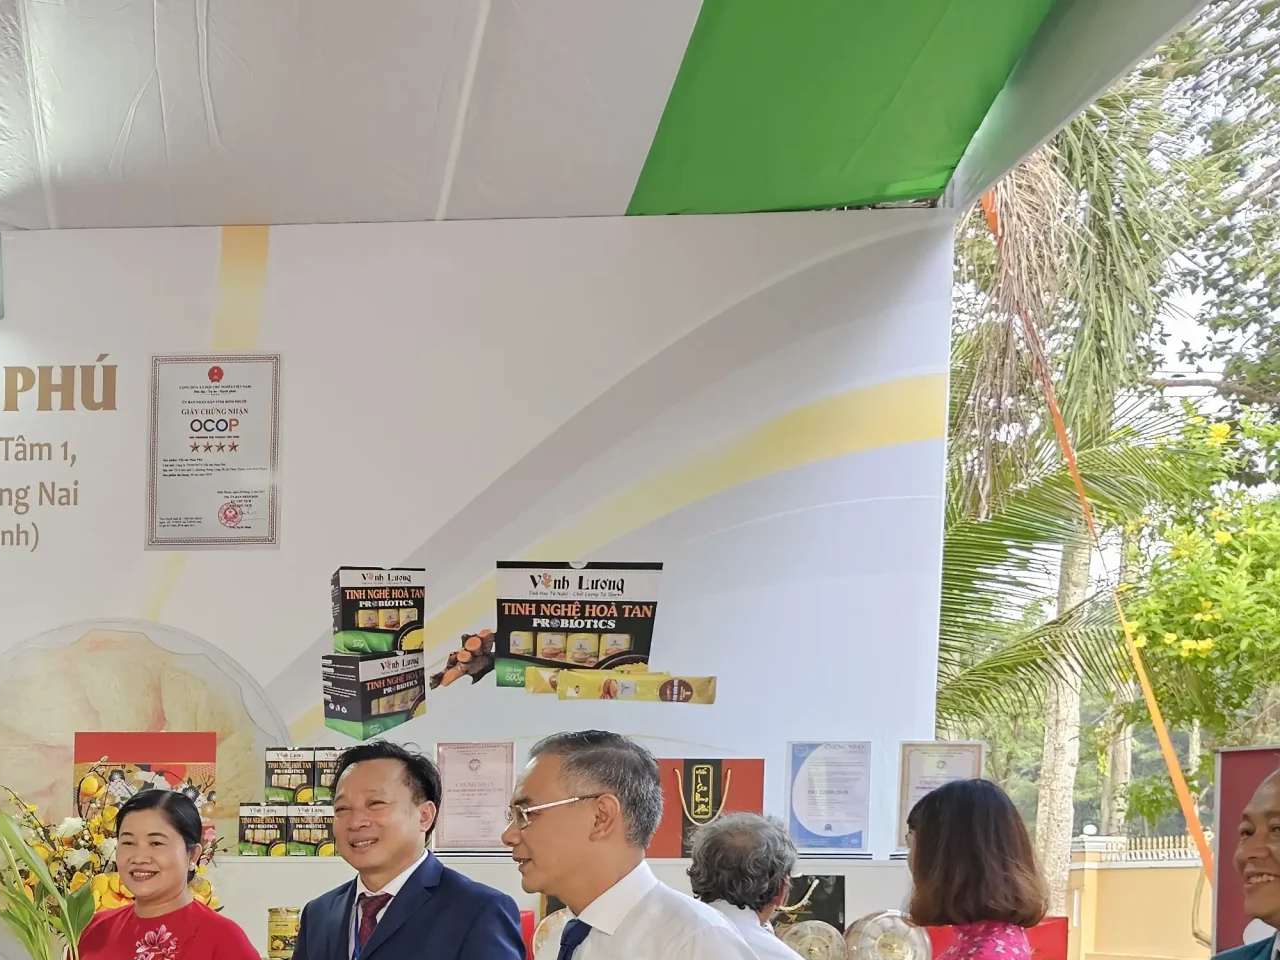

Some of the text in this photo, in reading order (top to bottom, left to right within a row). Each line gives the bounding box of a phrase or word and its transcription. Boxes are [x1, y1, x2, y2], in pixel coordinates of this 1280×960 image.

[3, 354, 118, 411] PHÚ
[190, 419, 239, 432] OCOP
[0, 435, 52, 461] Tâm
[61, 441, 76, 467] 1,
[39, 479, 79, 506] Nai
[345, 590, 365, 599] TINH
[368, 587, 390, 599] NGHỆ
[410, 589, 425, 598] TAN
[578, 576, 624, 596] Lương
[359, 600, 413, 608] PROBIOTICS
[502, 603, 536, 615] TINH
[540, 601, 581, 619] NGHỆ
[622, 605, 653, 617] TAN
[532, 618, 615, 628] PROBIOTICS
